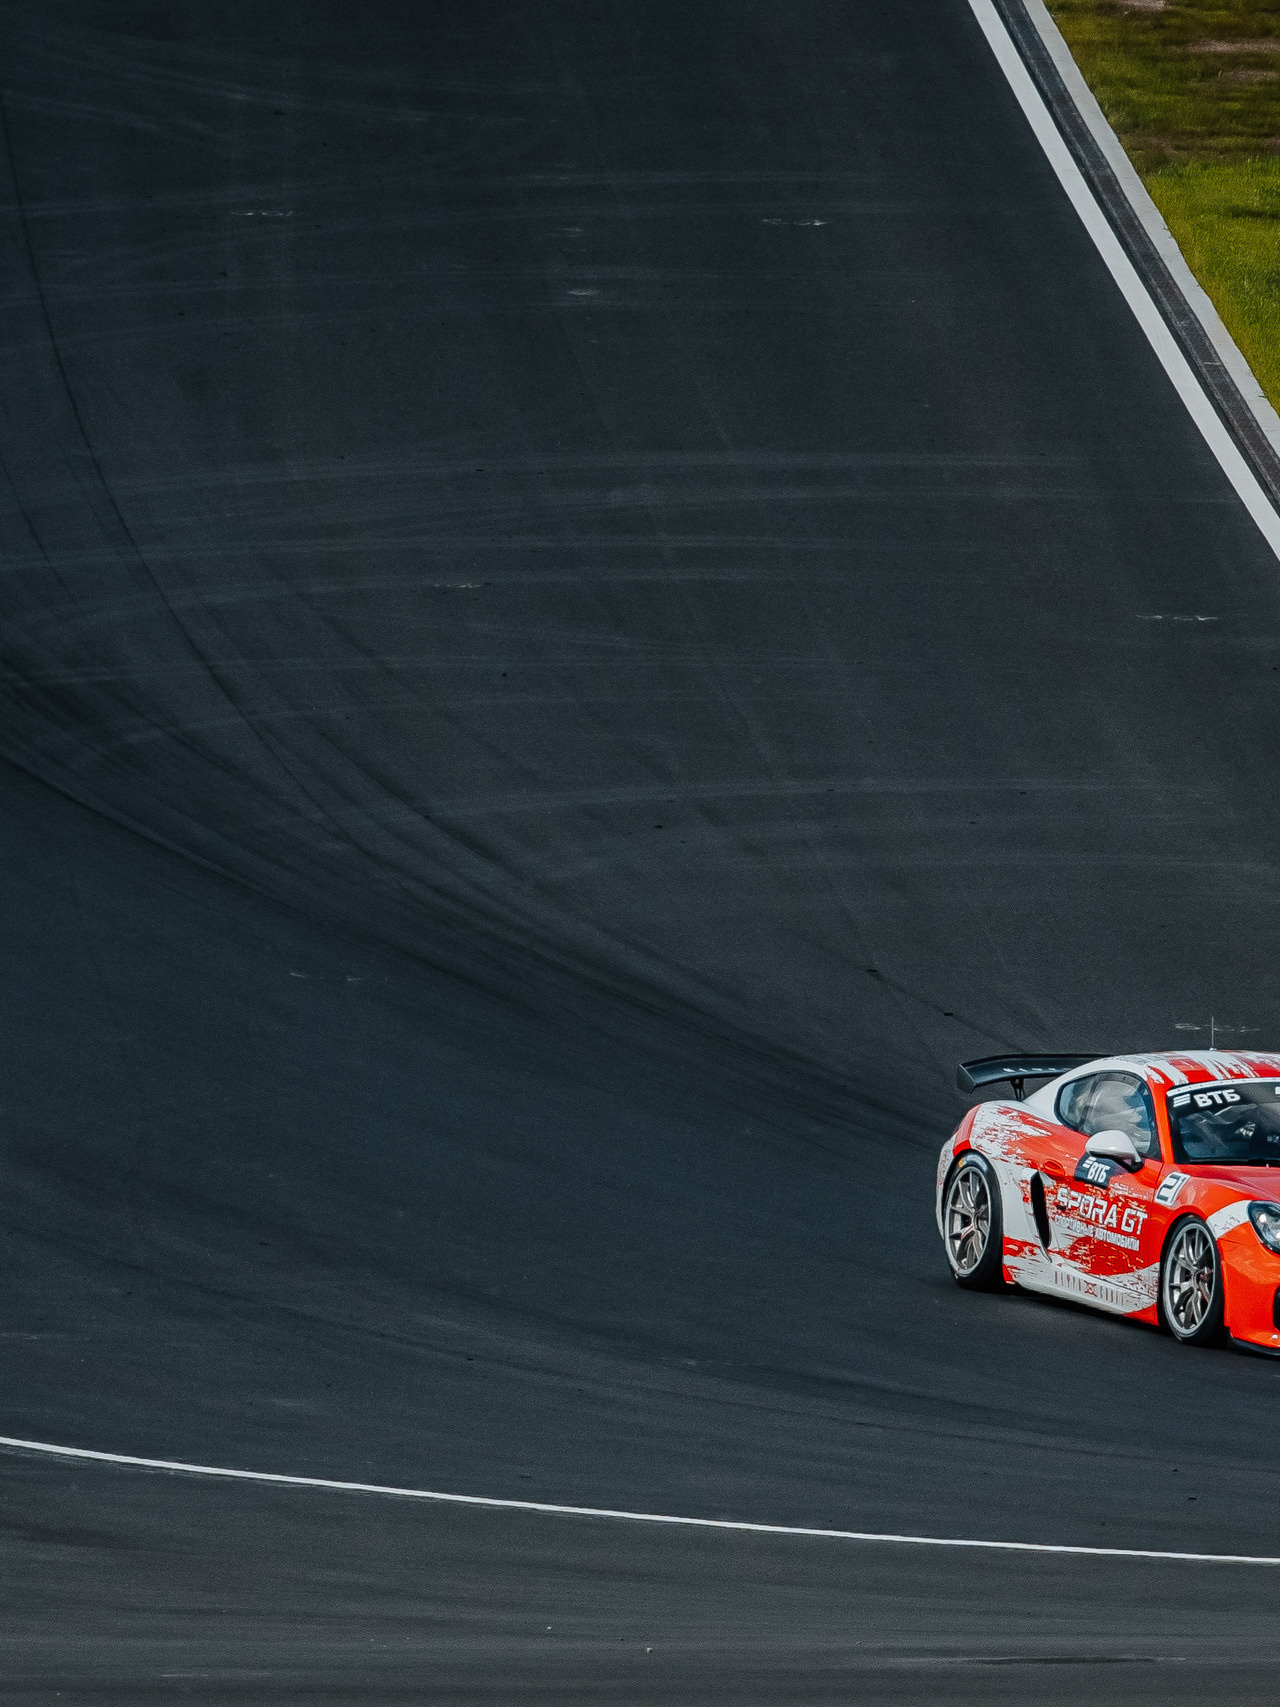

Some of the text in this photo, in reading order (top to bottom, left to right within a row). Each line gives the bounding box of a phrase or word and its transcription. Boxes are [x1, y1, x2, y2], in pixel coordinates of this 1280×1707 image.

[1193, 1089, 1241, 1107] ВТБ
[1087, 1162, 1110, 1183] ВТБ
[1057, 1187, 1148, 1235] SPORA GT
